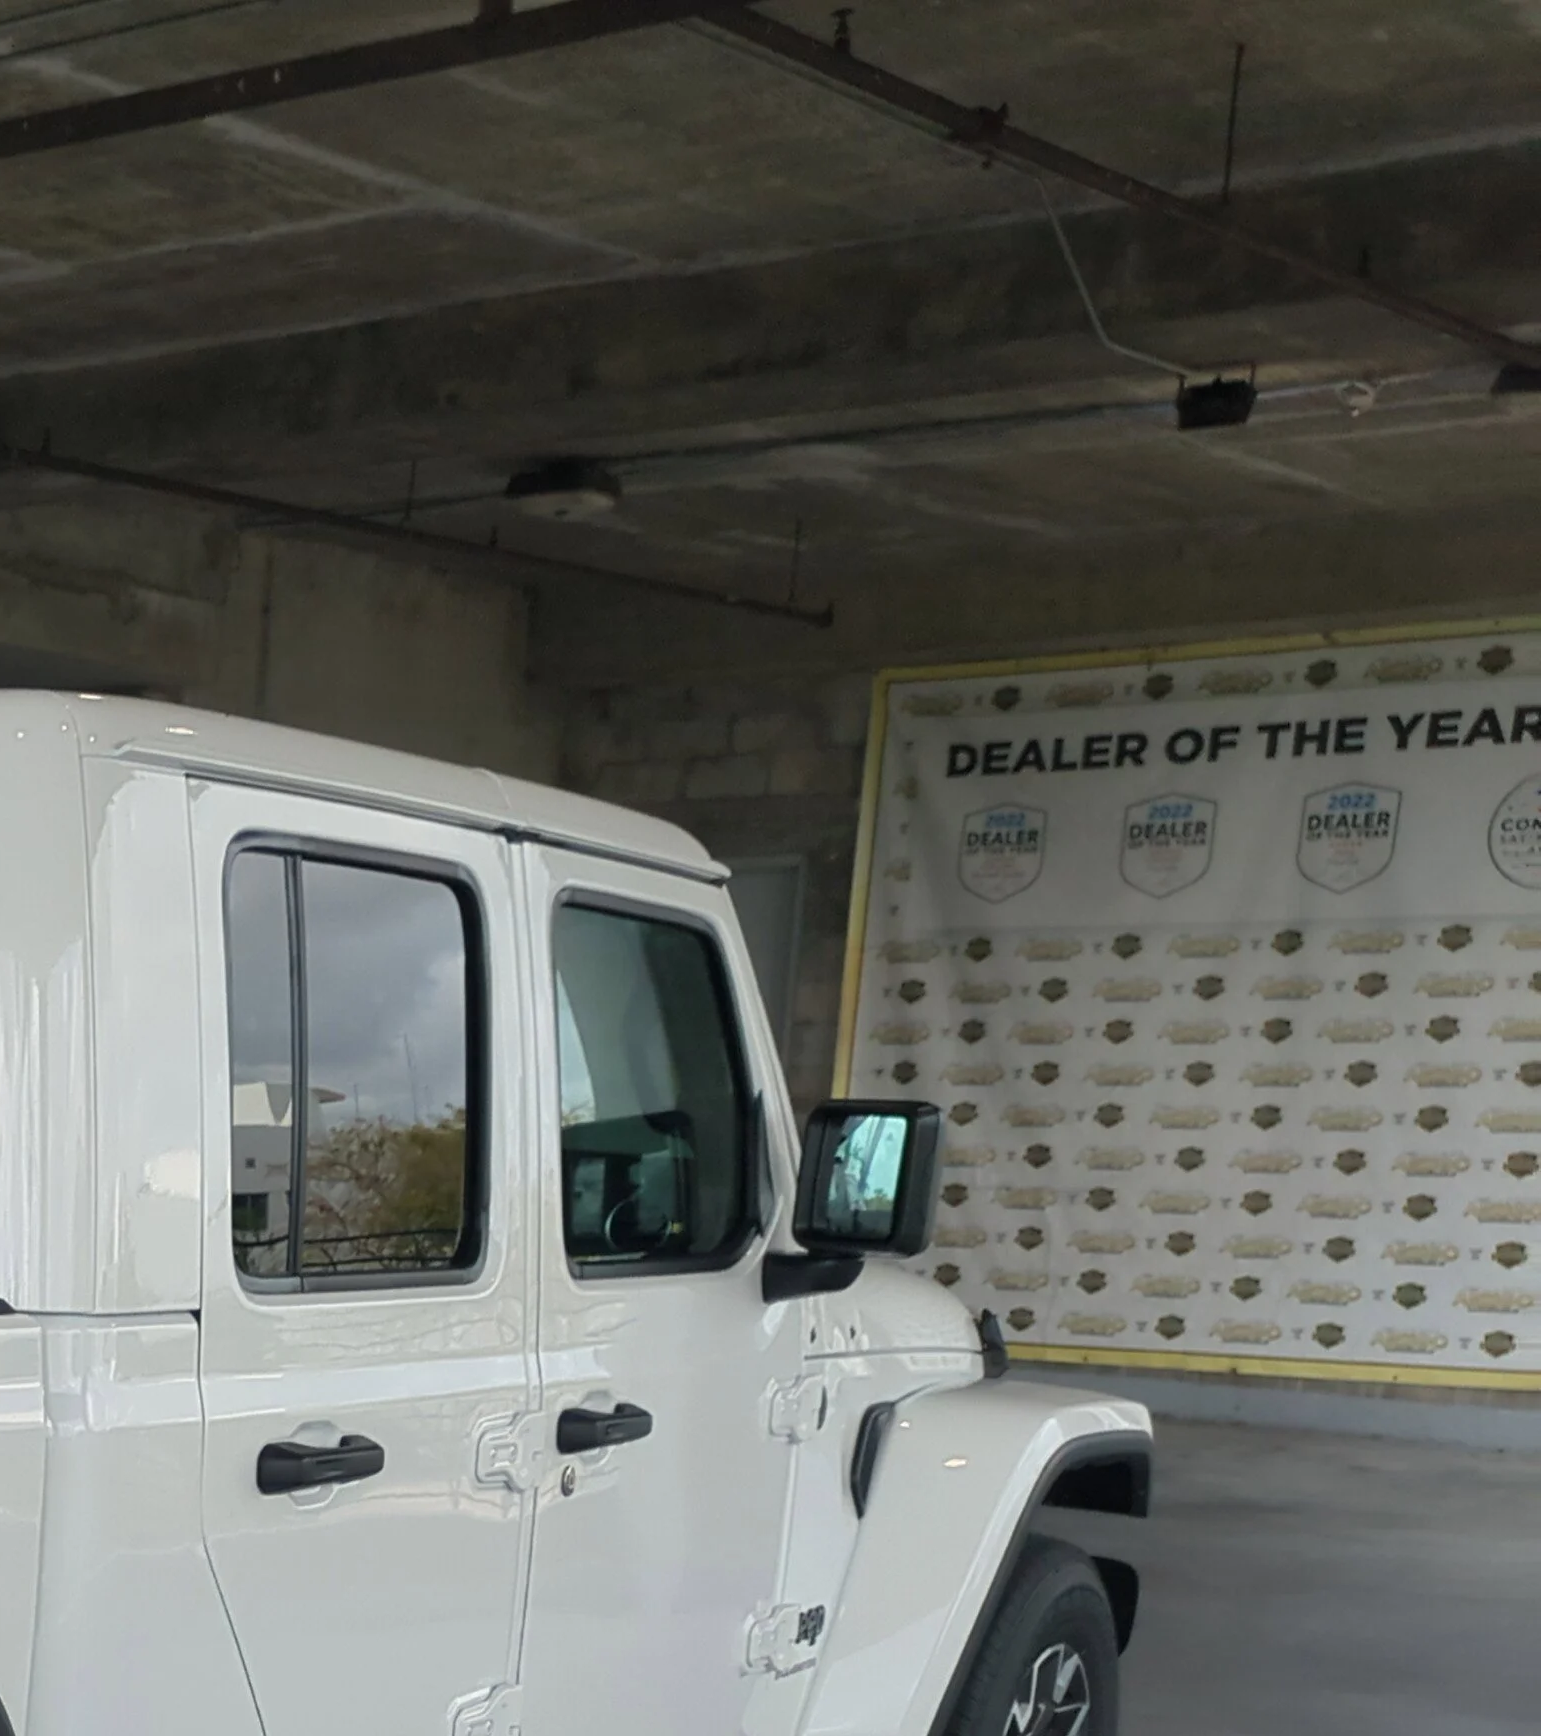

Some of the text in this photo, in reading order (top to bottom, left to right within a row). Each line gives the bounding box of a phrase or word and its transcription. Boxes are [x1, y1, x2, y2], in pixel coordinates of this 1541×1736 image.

[946, 705, 1541, 778] DEALER OF THE YEAR
[1128, 820, 1208, 841] DEALER
[1307, 811, 1391, 830] DEALER
[966, 829, 1039, 848] DEALER
